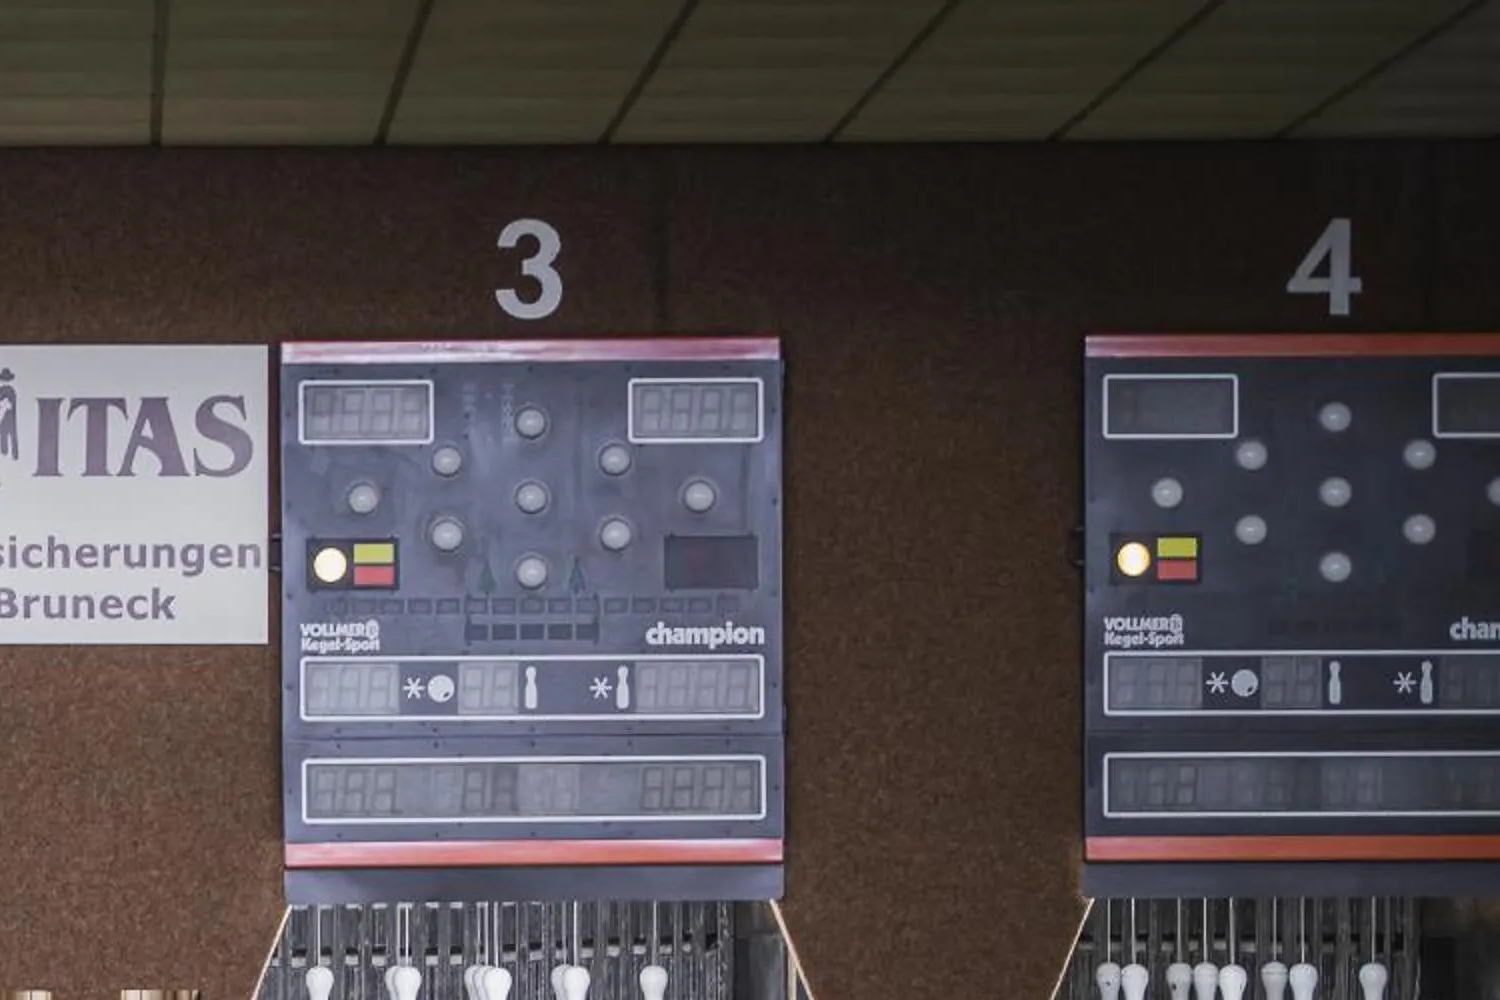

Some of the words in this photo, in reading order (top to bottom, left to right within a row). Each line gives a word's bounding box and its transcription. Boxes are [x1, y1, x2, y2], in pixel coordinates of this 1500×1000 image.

[495, 218, 563, 320] 3
[1286, 218, 1363, 316] 4
[31, 394, 254, 478] ITAS
[645, 621, 765, 649] champion
[1103, 617, 1169, 631] VOLLMER
